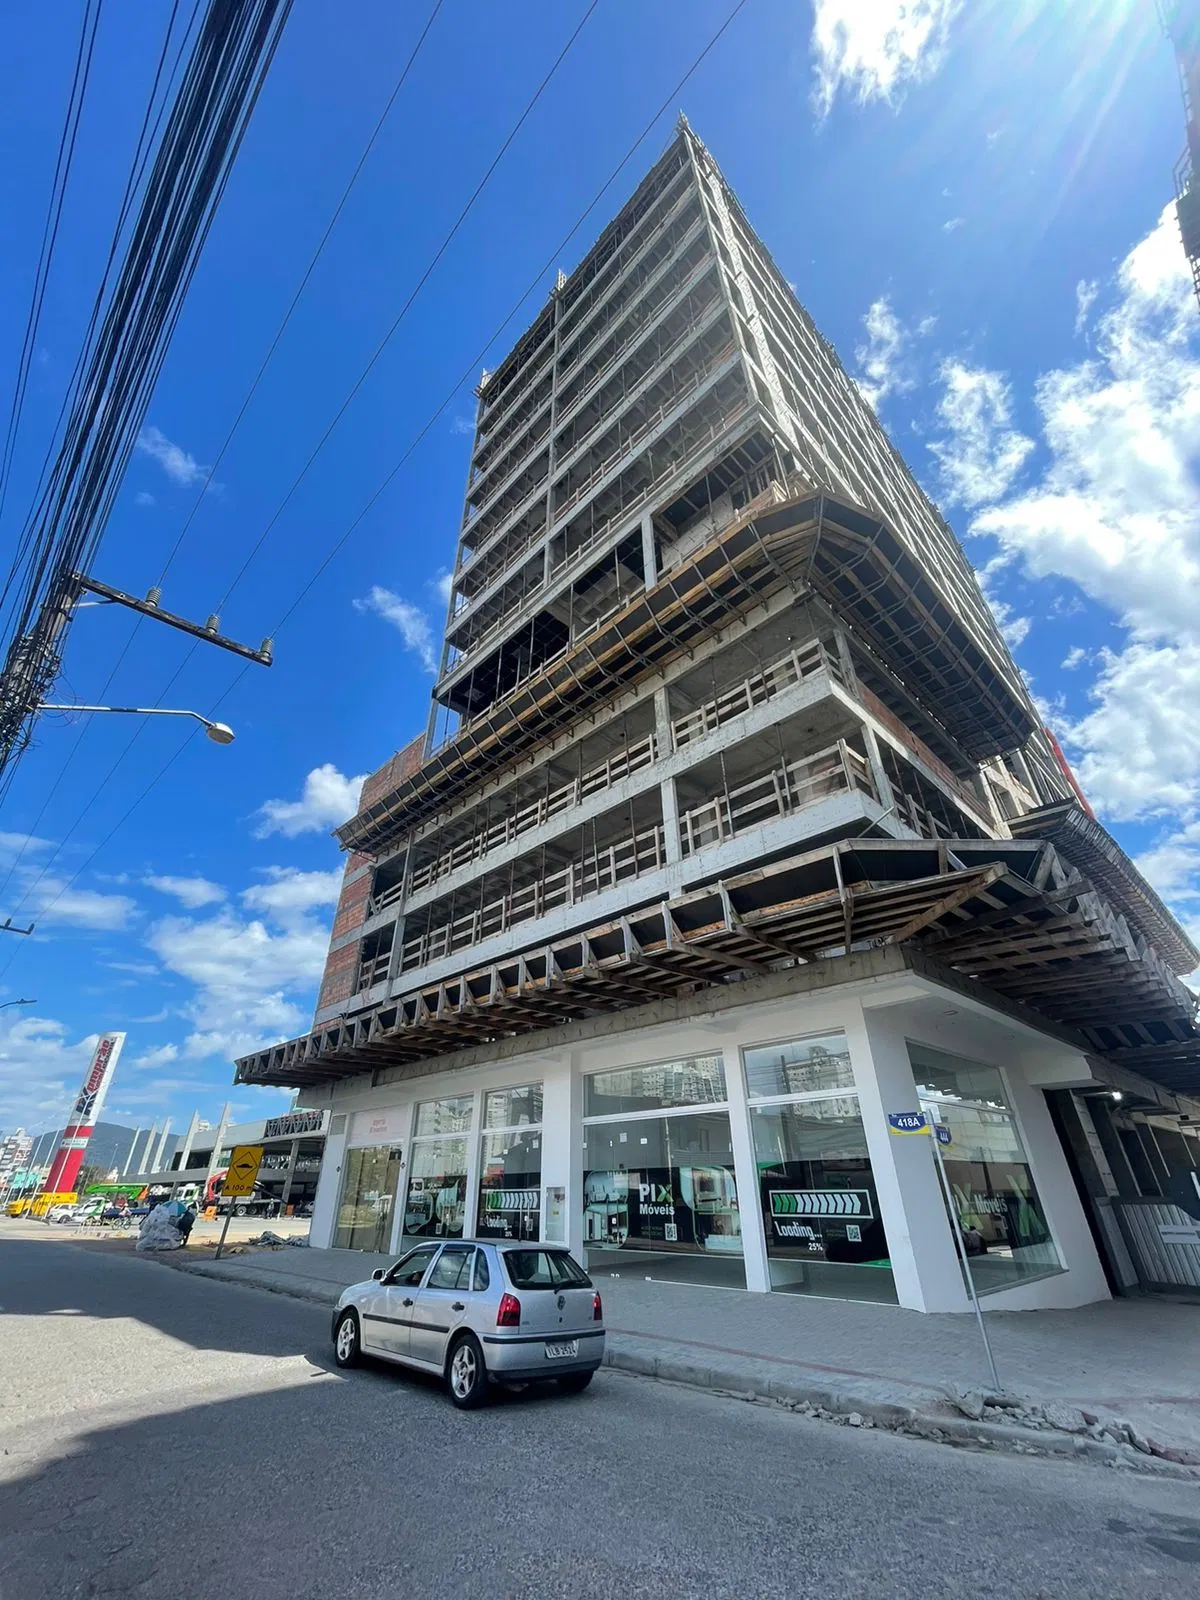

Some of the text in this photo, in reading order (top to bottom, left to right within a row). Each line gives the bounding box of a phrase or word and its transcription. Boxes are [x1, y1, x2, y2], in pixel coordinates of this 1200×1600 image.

[897, 1117, 921, 1127] 418A
[638, 1183, 674, 1203] PIX
[639, 1203, 675, 1216] Móveis
[808, 1242, 824, 1251] 25%
